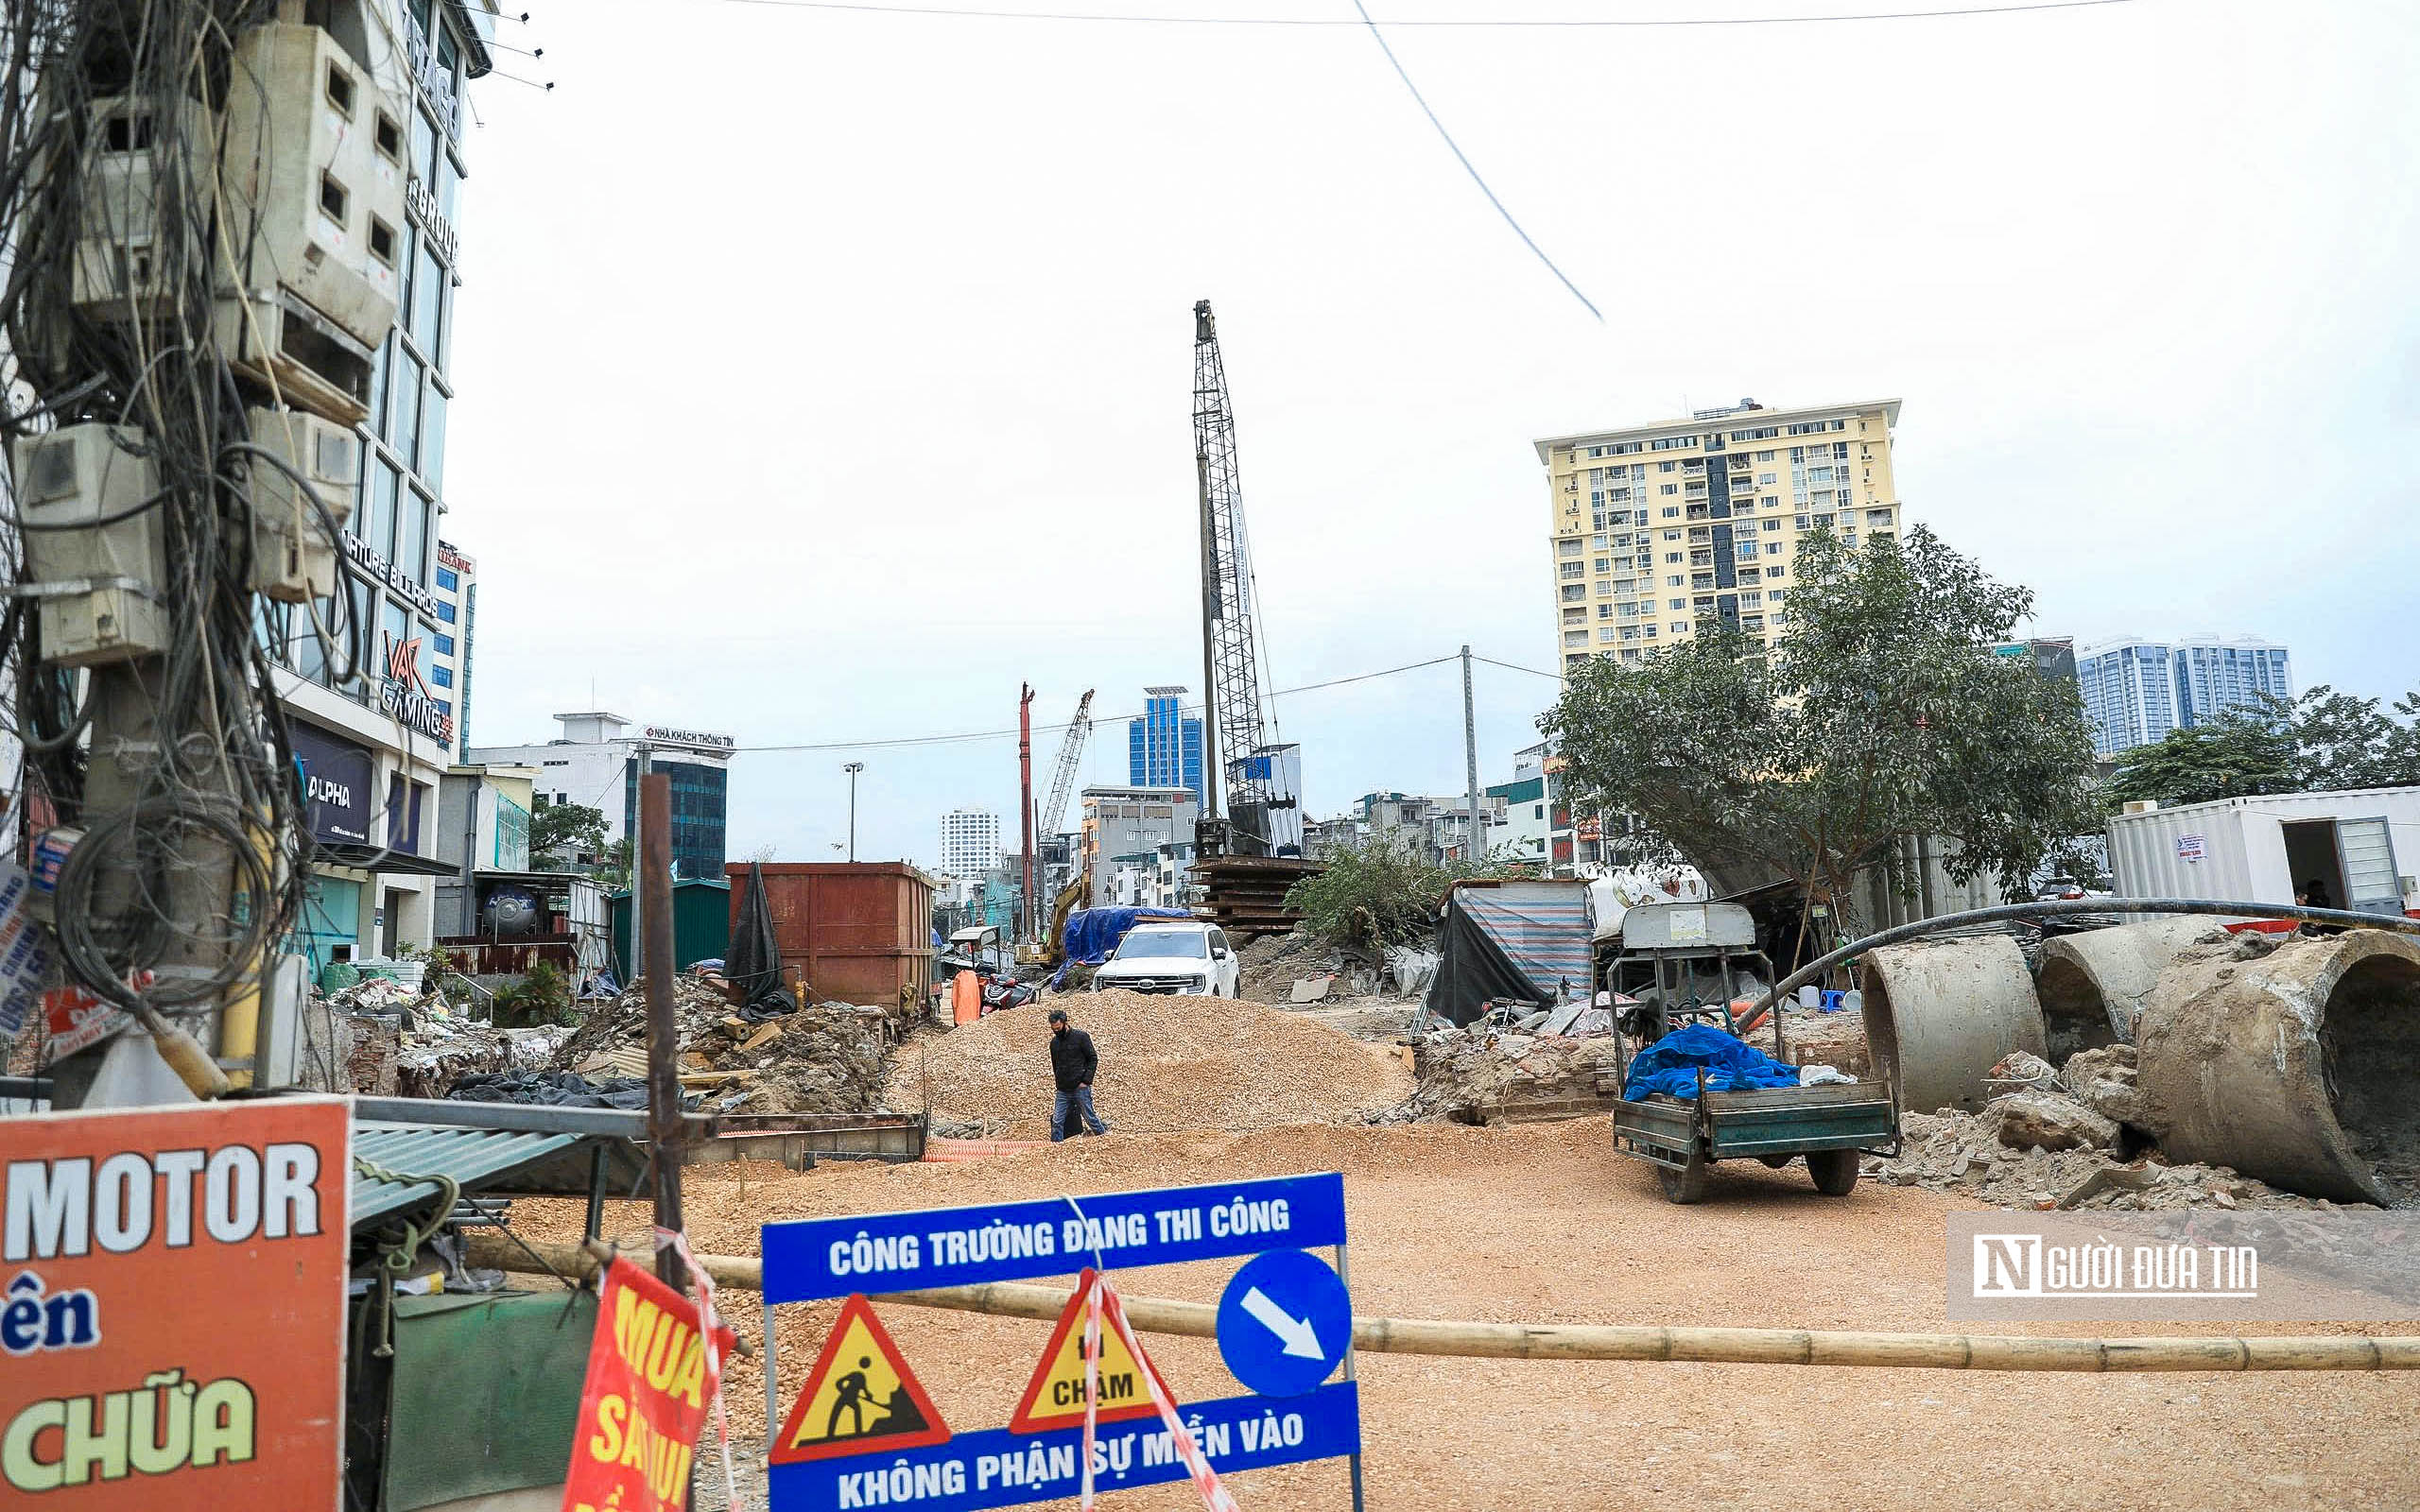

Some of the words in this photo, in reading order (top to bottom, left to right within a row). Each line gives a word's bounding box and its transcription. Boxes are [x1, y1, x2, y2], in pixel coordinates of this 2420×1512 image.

[341, 528, 389, 582] NATURE
[380, 681, 441, 736] GAMING
[654, 727, 670, 740] NHÀ
[671, 730, 697, 743] KHÁCH
[698, 733, 722, 746] THÔNG
[308, 776, 351, 809] ALPHA
[3, 1141, 323, 1263] MOTOR
[829, 1230, 920, 1276] CÔNG
[928, 1218, 1055, 1266] TRƯỜNG
[1063, 1213, 1148, 1254] ĐANG
[1154, 1208, 1201, 1242] THI
[1210, 1194, 1290, 1238] CÔNG
[615, 1283, 706, 1410] MUA
[2, 1367, 256, 1493] CHỮA
[838, 1458, 967, 1510] KHÔNG
[977, 1441, 1075, 1488] PHẬN
[1093, 1432, 1136, 1480] SỰ
[1142, 1414, 1231, 1467] MỄN
[1239, 1406, 1305, 1452] VÀO
